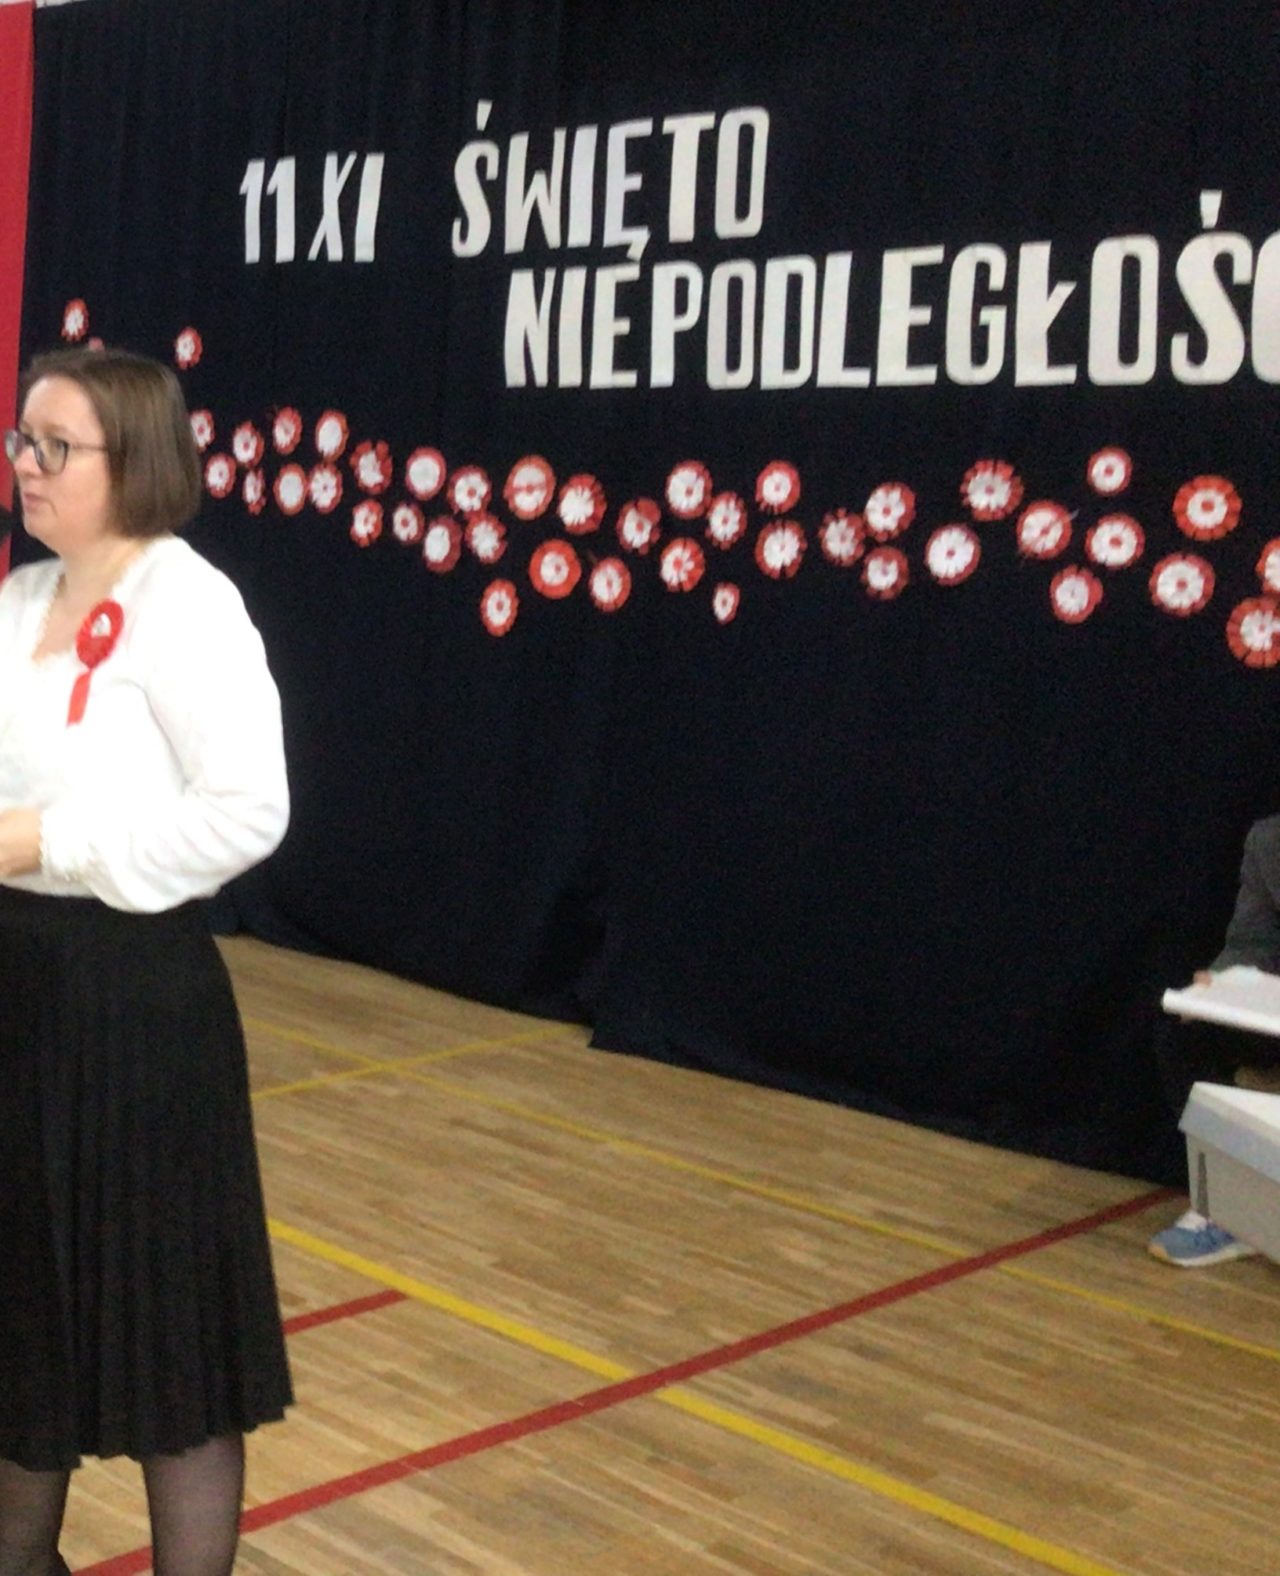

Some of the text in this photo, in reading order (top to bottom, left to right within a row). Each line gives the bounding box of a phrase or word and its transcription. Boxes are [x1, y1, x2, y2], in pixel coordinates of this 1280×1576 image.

[239, 101, 770, 263] 11 XI ŚWIĘTO
